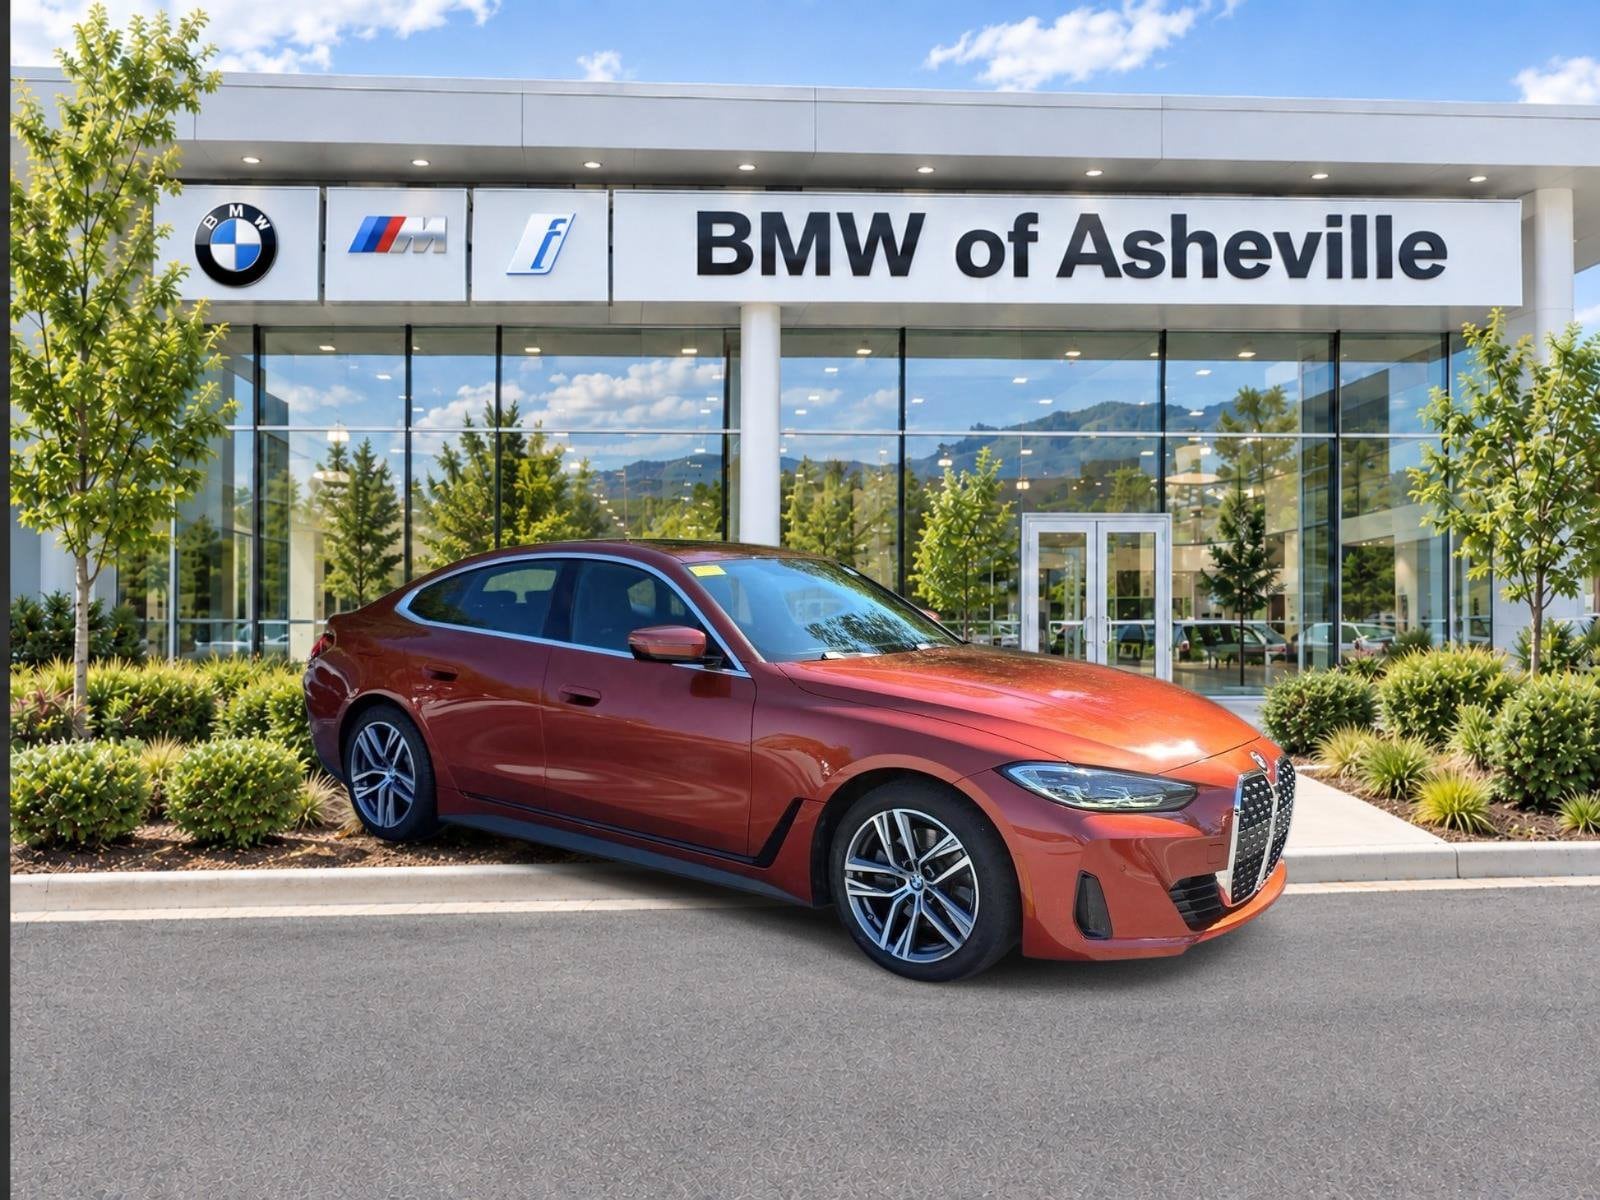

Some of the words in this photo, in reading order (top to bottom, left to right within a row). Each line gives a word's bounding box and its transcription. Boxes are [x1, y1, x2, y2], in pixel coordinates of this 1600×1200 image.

[203, 204, 271, 230] BMW
[696, 210, 926, 277] BMW
[955, 211, 1039, 279] of
[1056, 213, 1448, 281] Asheville
